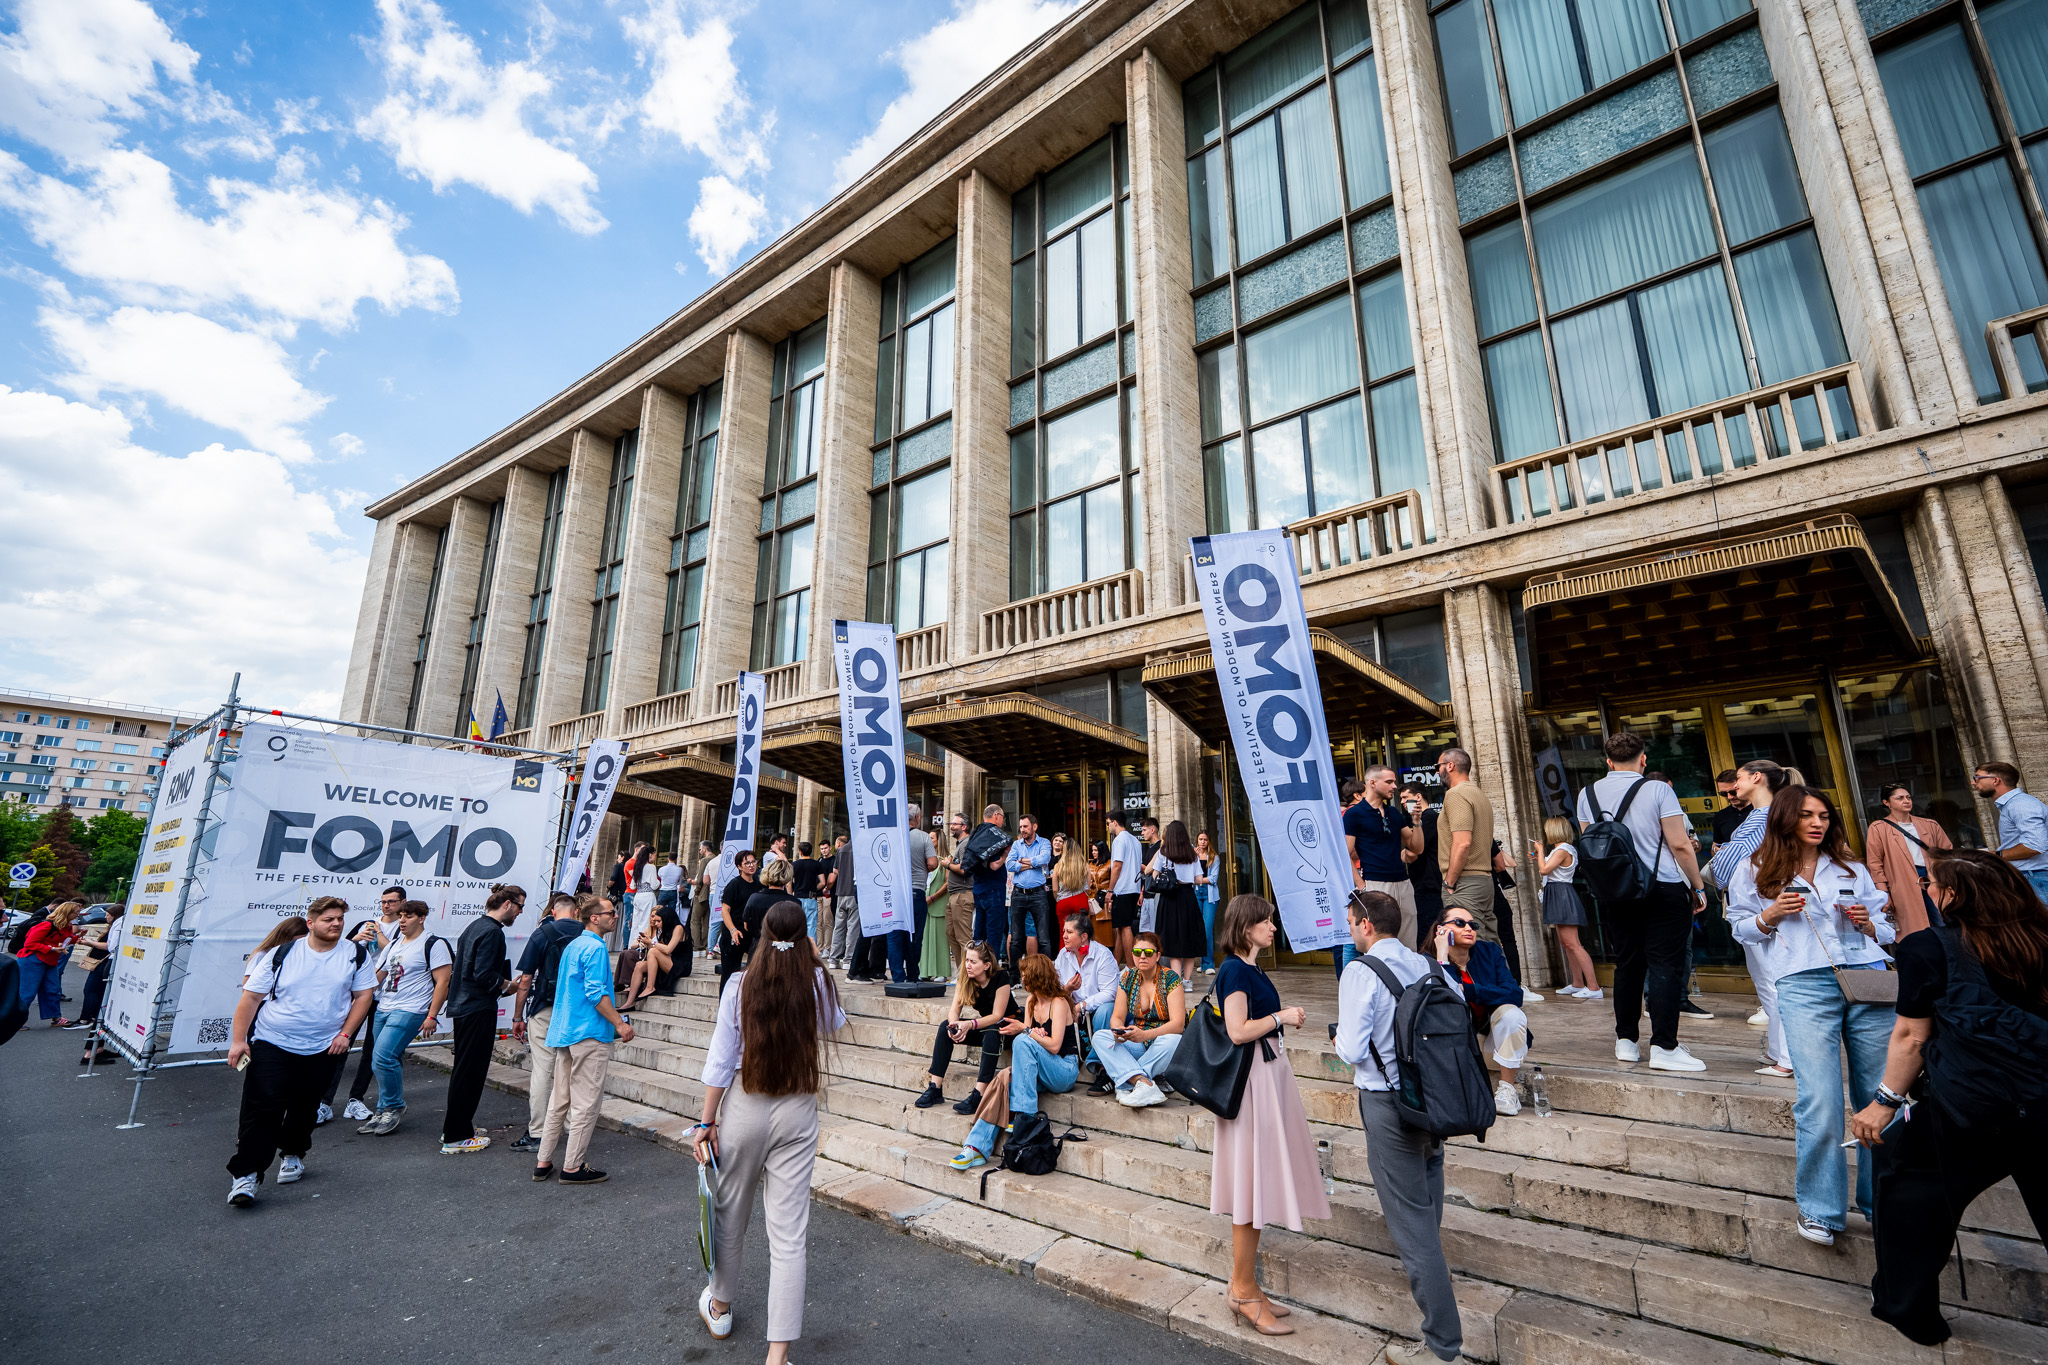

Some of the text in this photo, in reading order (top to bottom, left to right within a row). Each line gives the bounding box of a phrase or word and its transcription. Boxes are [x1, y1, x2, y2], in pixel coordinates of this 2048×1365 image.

[166, 766, 195, 806] FOMO
[516, 776, 538, 788] MO
[1403, 772, 1440, 784] FOM
[324, 784, 488, 814] WELCOME TO
[570, 755, 614, 858] FOMO
[584, 819, 597, 845] FESTIVAL
[600, 784, 611, 807] MODERN
[610, 758, 620, 781] OWNERS
[1124, 797, 1151, 808] FOM
[1704, 798, 1713, 810] 9
[256, 810, 518, 880] FOMO
[255, 872, 508, 889] THE FESTIVAL OF MODERN OWNE
